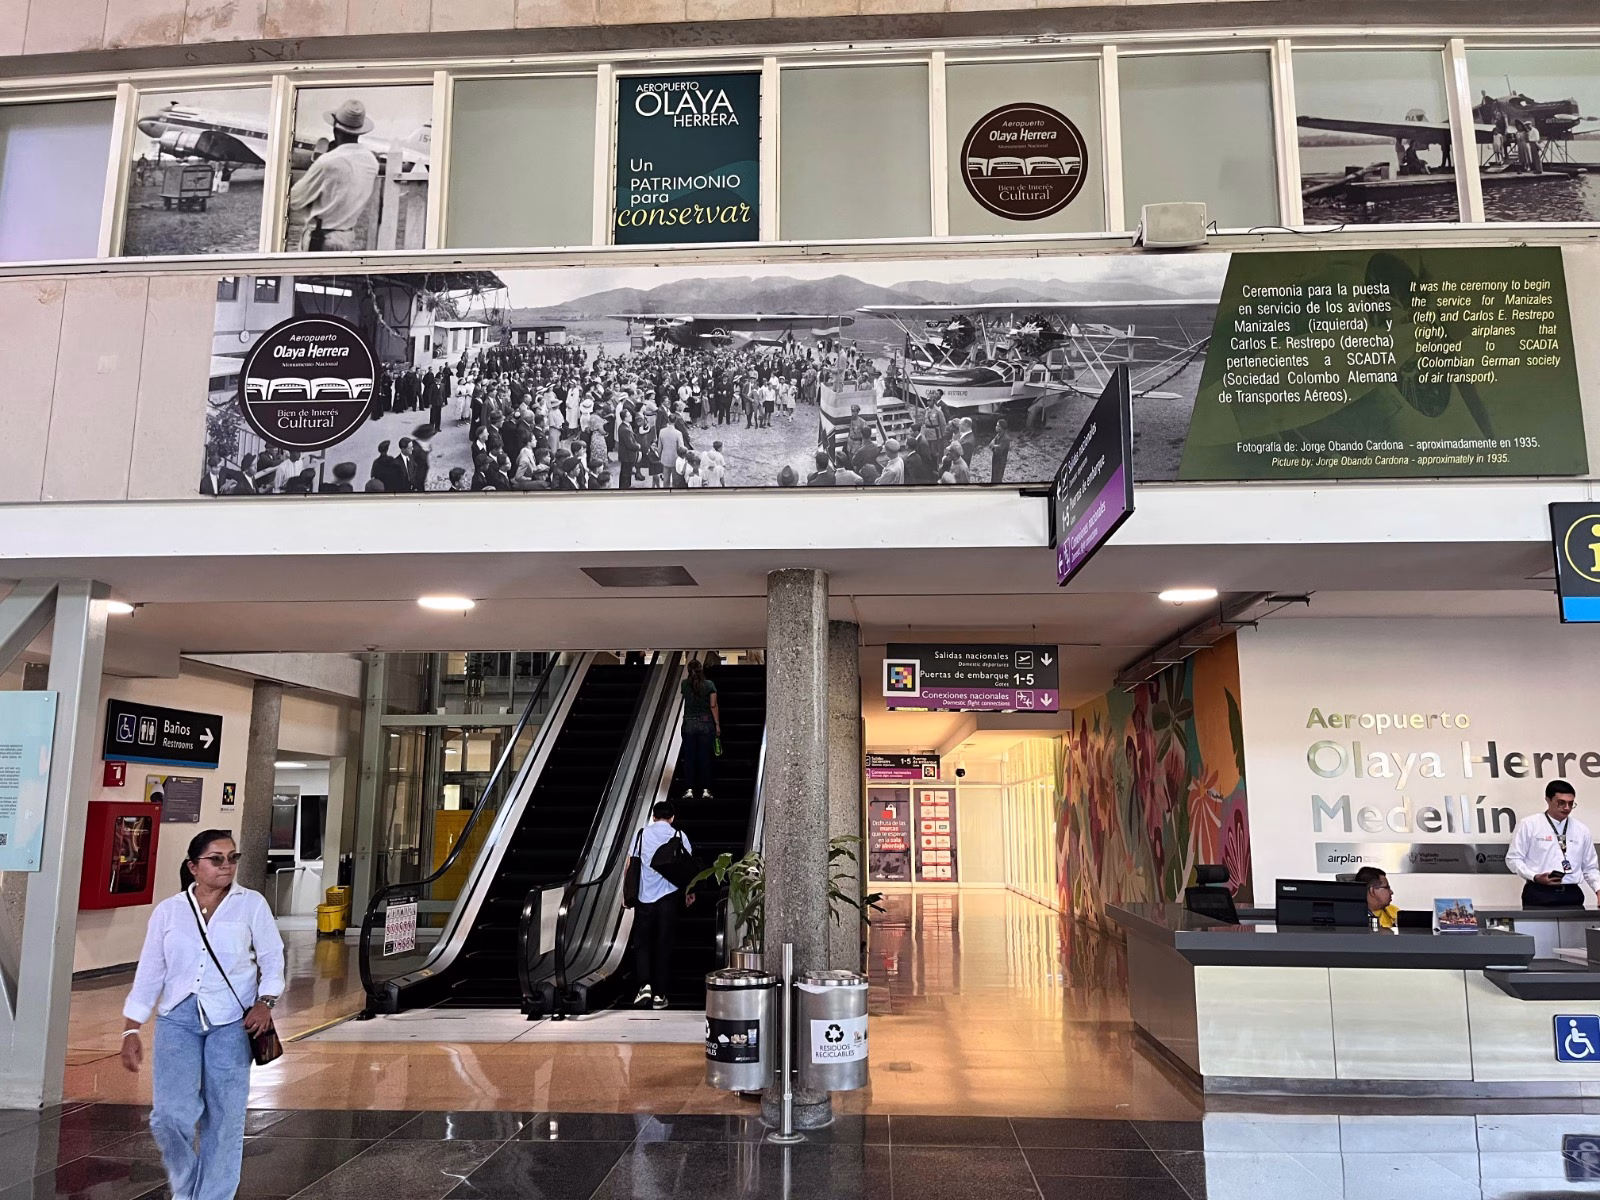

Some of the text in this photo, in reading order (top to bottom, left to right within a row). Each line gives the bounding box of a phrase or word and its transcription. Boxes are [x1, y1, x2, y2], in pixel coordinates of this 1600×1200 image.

[636, 82, 699, 92] AEROPUERTO
[635, 89, 734, 116] OLAYA
[674, 113, 739, 128] HERRERA
[1002, 120, 1044, 128] Aeropuerto
[989, 130, 1018, 142] Olaya
[1020, 128, 1057, 142] Herrera
[630, 158, 652, 172] Un
[630, 174, 740, 191] PATRIMONIO
[1028, 182, 1054, 190] Interés
[630, 193, 668, 208] para
[999, 190, 1050, 200] Cultural
[618, 202, 751, 226] conservar
[1242, 283, 1390, 298] Ceremonia para la puesta
[1410, 279, 1550, 292] It was the ceremony to begin
[1238, 300, 1391, 315] en servicio de los aviones
[1411, 294, 1552, 307] the service for Manizales
[1412, 309, 1555, 324] (left) and Carlos E. Restrepo
[1234, 318, 1392, 333] Manizales (izquierda) y
[1414, 324, 1557, 340] (right), airplanes that
[290, 334, 338, 342] Aeropuerto
[1230, 334, 1394, 352] Carlos E. Restrepo (derecha)
[274, 345, 306, 360] Olaya
[307, 342, 350, 358] Herrera
[1416, 339, 1560, 355] belonged to SCADTA
[1226, 352, 1396, 370] pertenecientes a SCADTA
[1417, 355, 1560, 370] (Colombian German society
[1222, 370, 1398, 388] (Sociedad Colombo Alemana
[1418, 370, 1498, 384] of air transport).
[1218, 388, 1352, 405] de Transportes Aéreos).
[298, 408, 309, 416] de
[311, 408, 338, 416] Interés
[278, 416, 334, 429] Cultural
[1236, 442, 1282, 454] Fotografía
[1284, 441, 1298, 452] de:
[1300, 441, 1326, 454] Jorge
[1328, 440, 1364, 452] Obando
[1366, 440, 1404, 450] Cardona
[1416, 438, 1497, 451] aproximadamente
[1500, 439, 1511, 448] en
[1514, 436, 1541, 448] 1935.
[1272, 457, 1300, 466] Picture
[1301, 457, 1314, 468] by:
[1316, 456, 1338, 468] Jorge
[1340, 456, 1372, 466] Obando
[1374, 455, 1408, 465] Cardona
[1417, 454, 1474, 466] approximately
[1476, 454, 1484, 463] in
[1486, 454, 1510, 463] 1935.
[934, 651, 1009, 660] Salidas nacionales
[920, 670, 1034, 686] Puertas de embarque 1-5
[922, 690, 1010, 700] Conexiones nacionales
[163, 719, 191, 736] Baños
[1306, 707, 1472, 735] Aeropuerto
[162, 737, 194, 750] Restrooms
[1306, 740, 1446, 790] Olaya
[1311, 794, 1516, 834] Medellín
[1328, 850, 1362, 865] airplan
[816, 1050, 854, 1058] RECICLABLES
